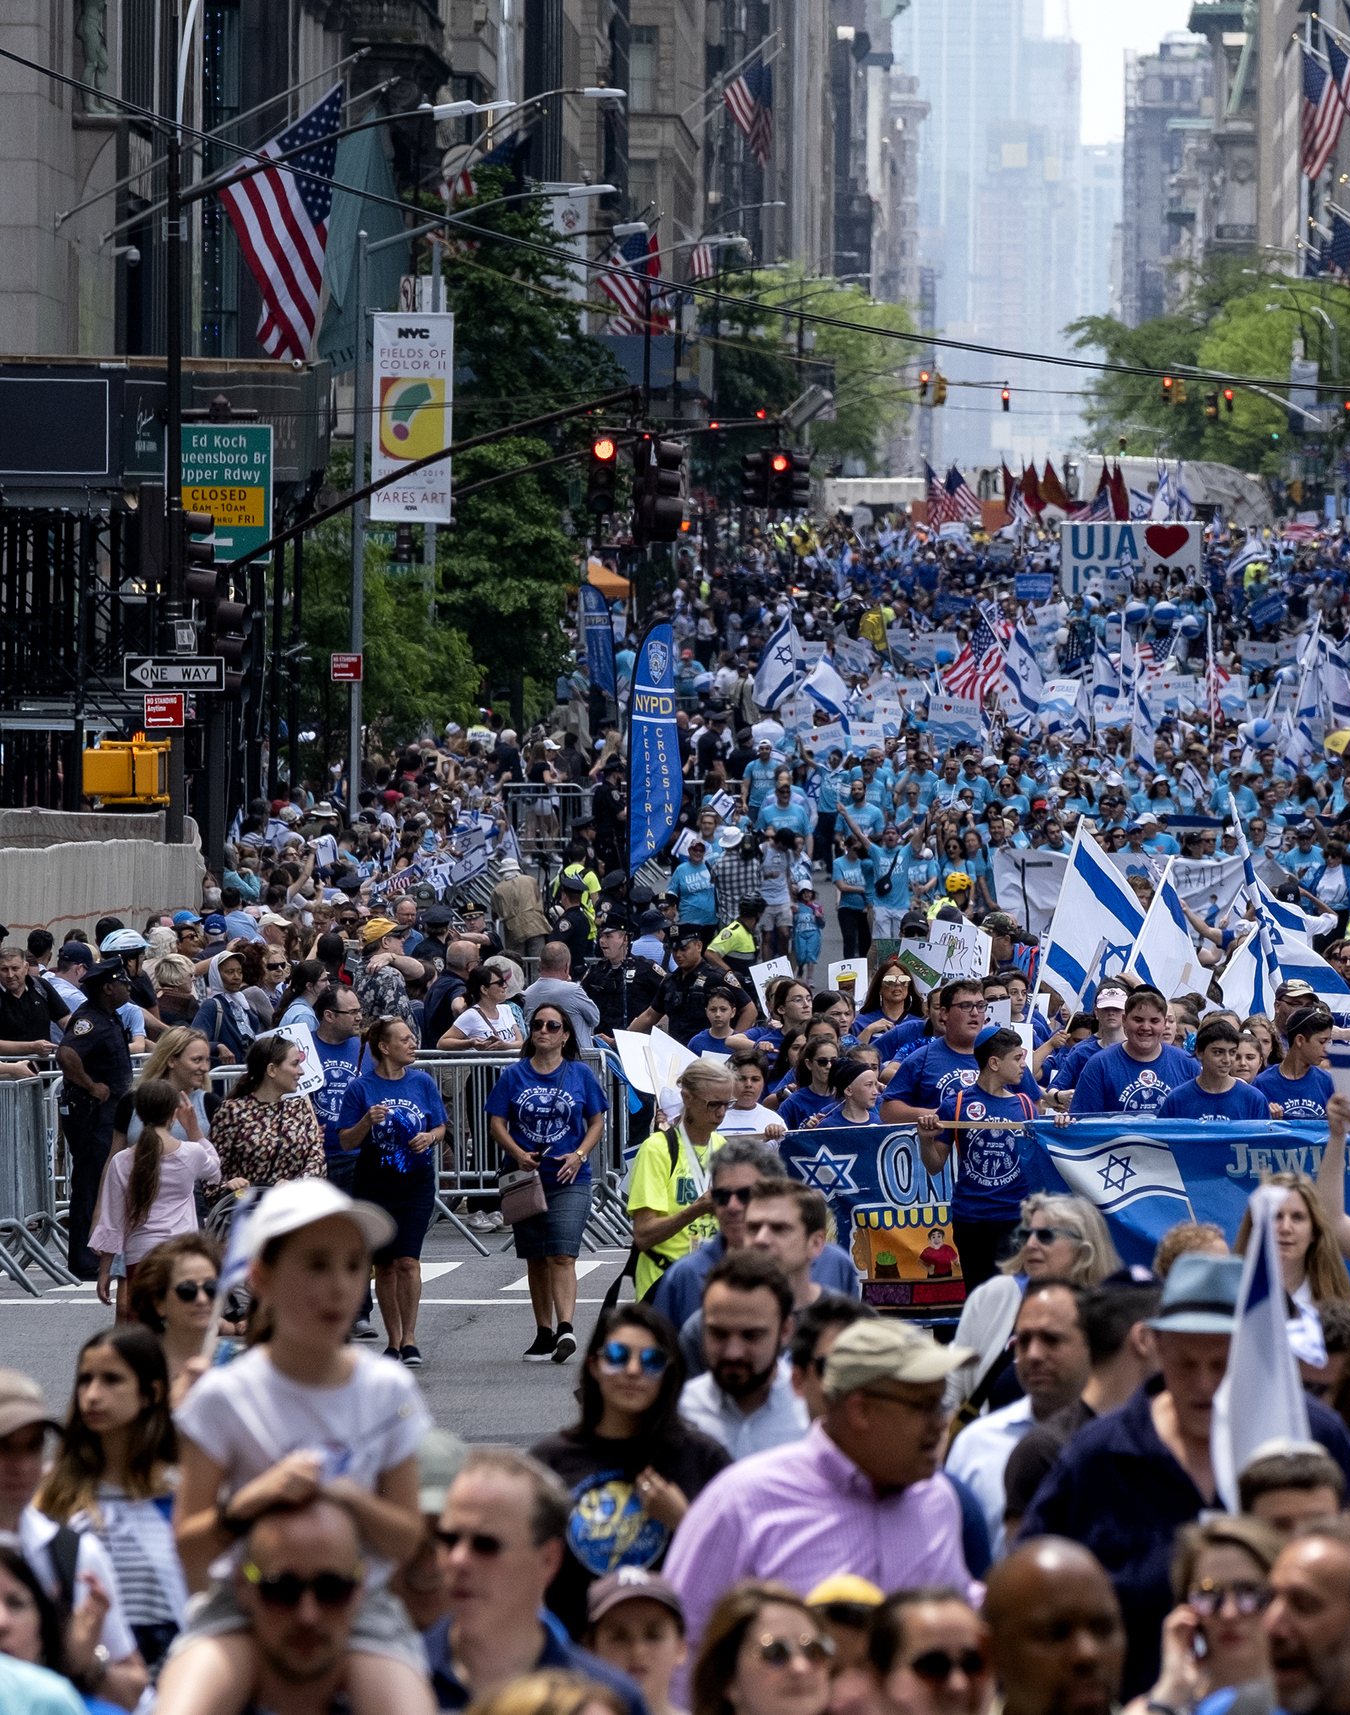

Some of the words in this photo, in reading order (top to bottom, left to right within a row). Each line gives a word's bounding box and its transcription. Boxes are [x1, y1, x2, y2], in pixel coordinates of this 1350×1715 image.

[398, 327, 430, 339] NYC
[380, 348, 424, 359] FIELDS
[429, 349, 447, 359] OF
[380, 360, 430, 371] COLOR
[192, 434, 208, 448] Ed
[213, 434, 247, 448] Koch
[181, 452, 248, 464] ueensboro
[253, 452, 267, 464] Br
[224, 468, 261, 483] Rdwy
[422, 469, 445, 477] 2019
[191, 489, 247, 501] CLOSED
[375, 491, 416, 504] YARES
[420, 492, 447, 504] ART
[192, 503, 212, 512] 6AM
[221, 503, 246, 512] 10AM
[237, 515, 255, 524] FRI
[1071, 524, 1140, 560] UJA
[140, 667, 168, 681] ONE
[181, 667, 211, 681] WAY
[154, 697, 178, 706] STANDING
[635, 693, 673, 715] NYPD
[931, 702, 944, 712] UJA
[952, 705, 978, 717] ISRAEL
[655, 728, 673, 826] CROSSING
[643, 725, 656, 850] PEDESTRIAN
[1174, 866, 1225, 889] SRAEL
[949, 923, 963, 933] רק
[918, 942, 933, 951] רק
[767, 962, 778, 971] רק
[840, 963, 852, 971] רק
[978, 1176, 993, 1187] Milk
[688, 1224, 718, 1237] STA
